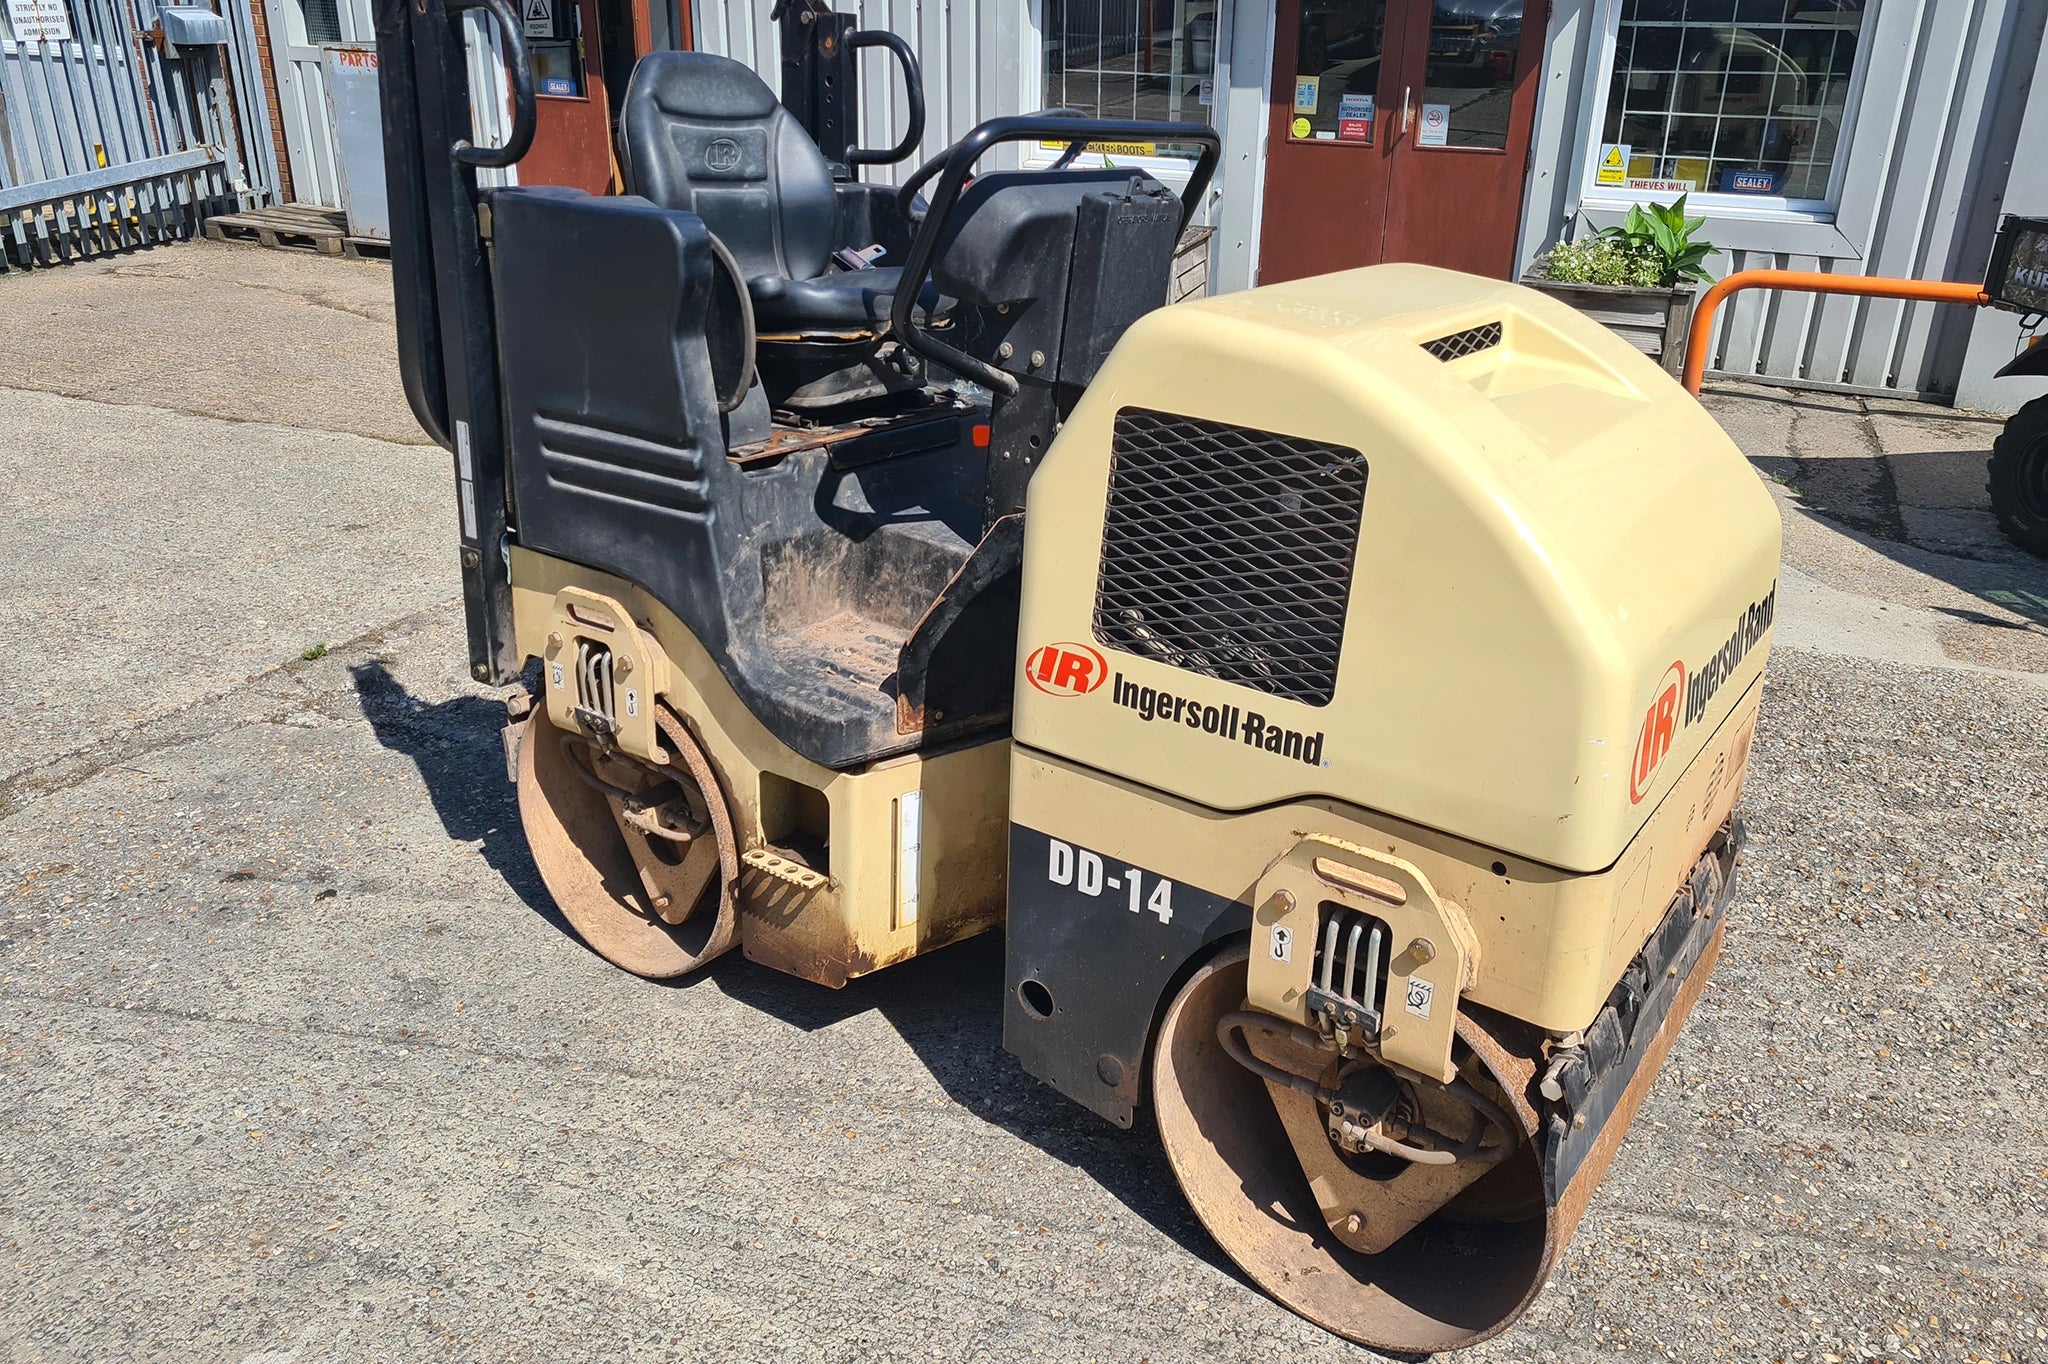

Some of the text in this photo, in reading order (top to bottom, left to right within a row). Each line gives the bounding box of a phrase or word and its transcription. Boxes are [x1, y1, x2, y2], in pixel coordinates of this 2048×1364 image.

[13, 16, 65, 24] UNAUTHORISED
[24, 28, 61, 36] ADMISSION
[339, 51, 378, 68] PARTS
[1117, 144, 1146, 156] BOOTS
[1629, 180, 1688, 191] THIEVES WILL
[1736, 177, 1769, 188] SEALEY
[1036, 645, 1094, 694] IR
[1637, 682, 1677, 787] IR
[1049, 838, 1174, 925] DD-14
